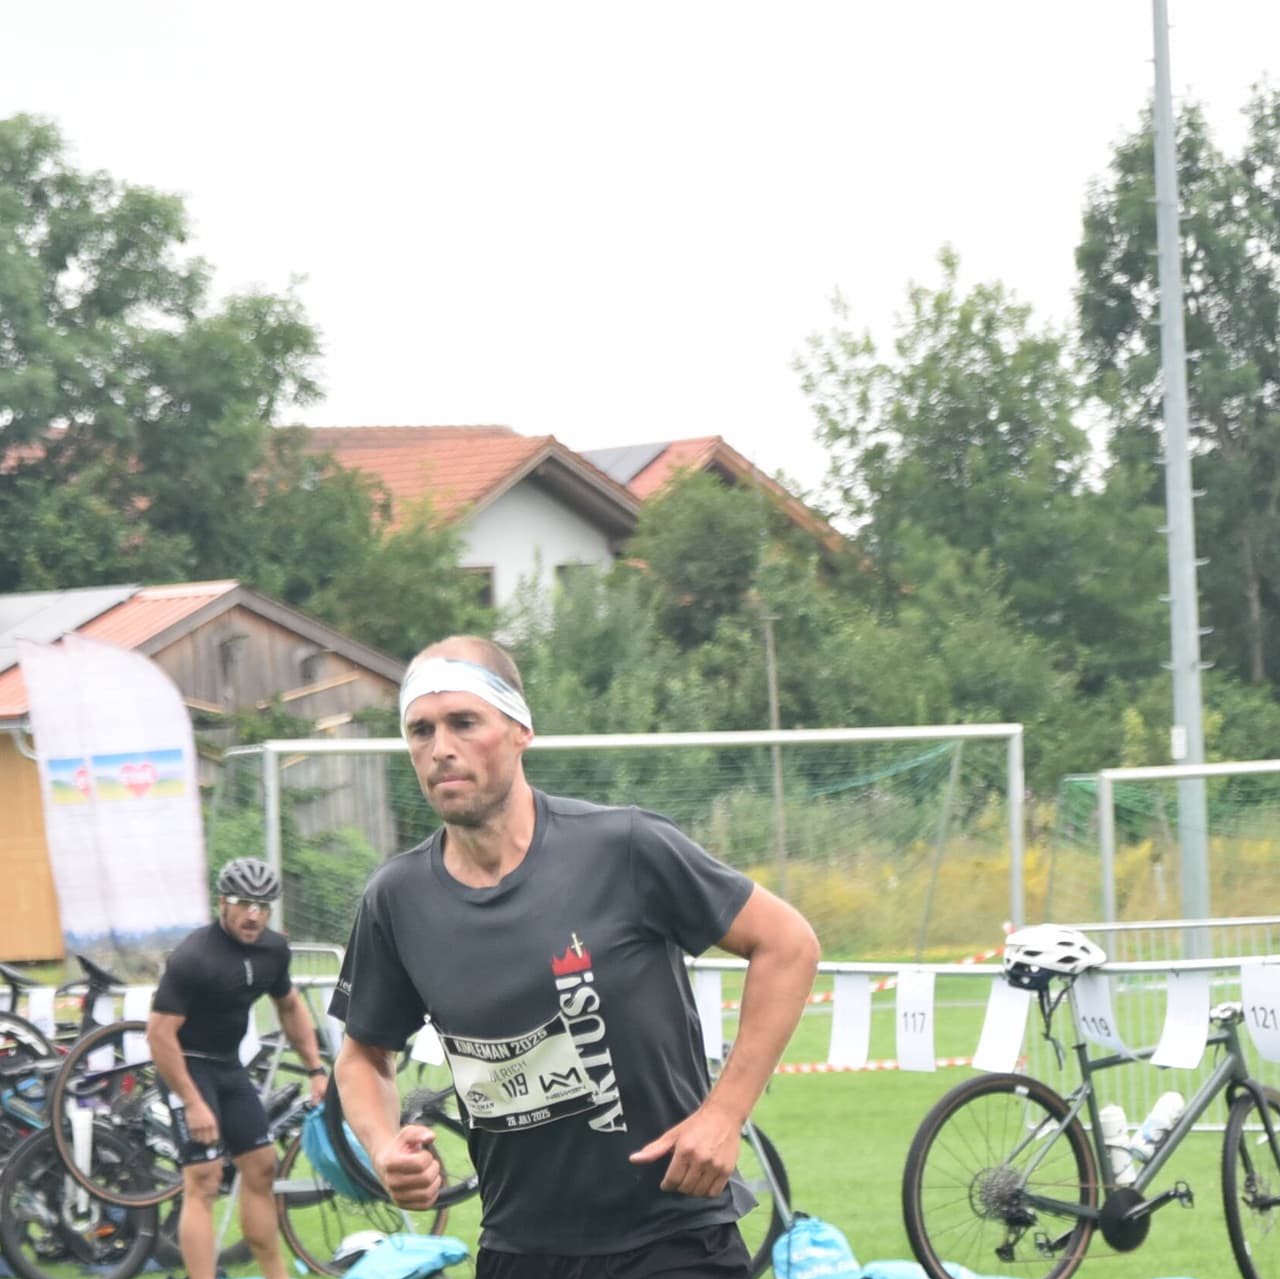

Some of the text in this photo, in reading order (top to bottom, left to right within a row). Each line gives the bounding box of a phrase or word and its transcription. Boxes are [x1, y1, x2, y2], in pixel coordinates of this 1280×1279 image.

[903, 1011, 926, 1032] 117
[1081, 1015, 1112, 1038] 119
[1250, 1005, 1278, 1030] 121
[511, 1029, 548, 1054] 2025
[502, 1072, 529, 1098] 119
[531, 1108, 551, 1123] 2025
